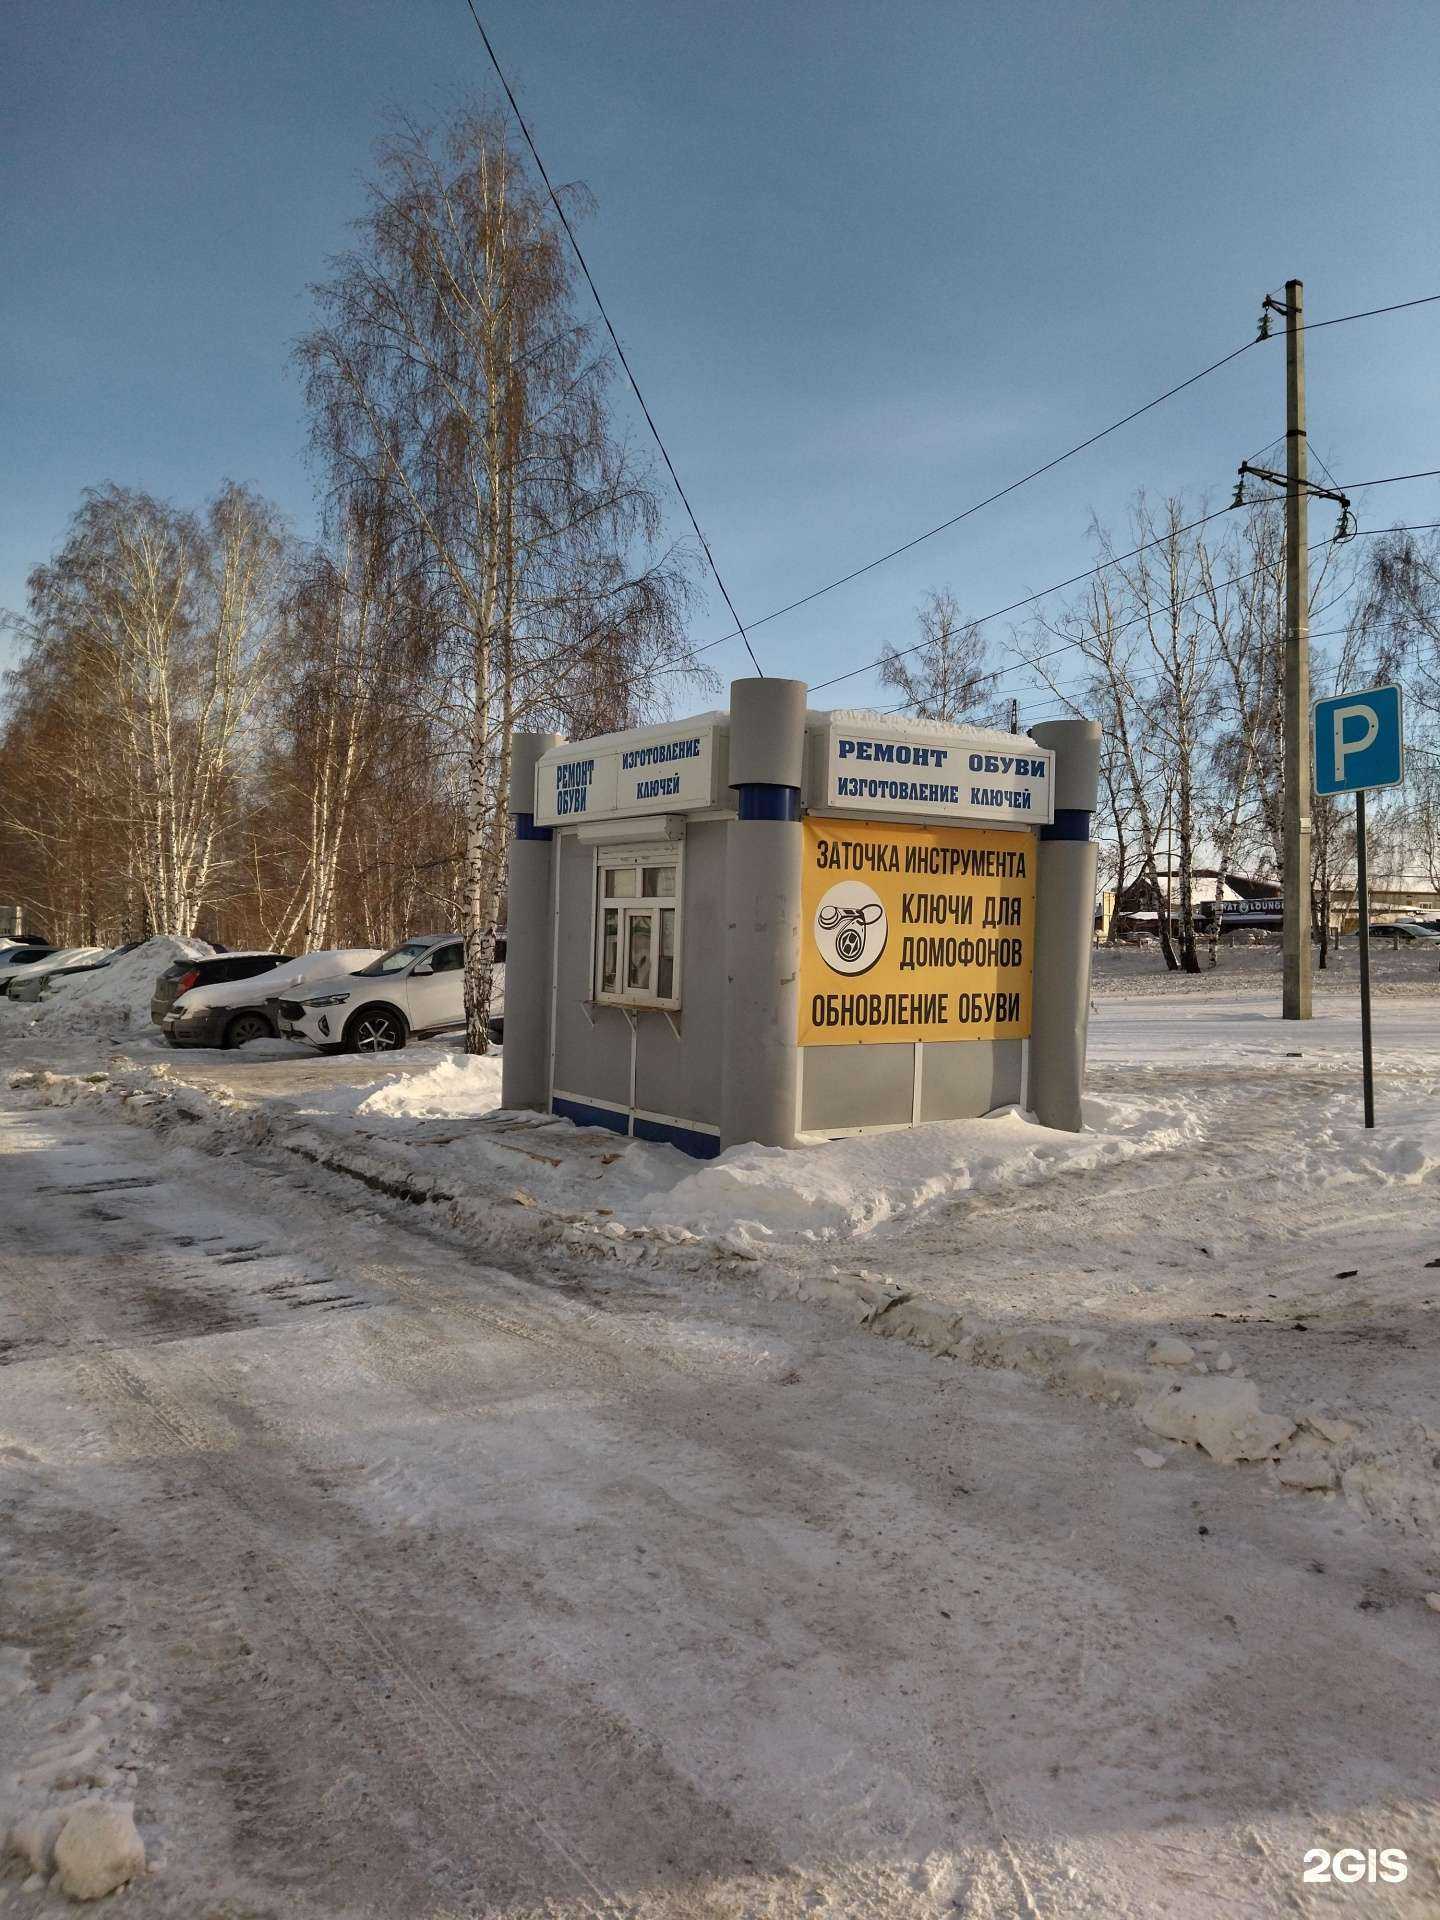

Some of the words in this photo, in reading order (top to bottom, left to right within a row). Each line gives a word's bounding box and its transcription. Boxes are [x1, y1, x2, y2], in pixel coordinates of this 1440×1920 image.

[622, 738, 701, 770] ИЗГОТОВЛЕНИЕ
[838, 739, 948, 768] РЕМОНТ
[968, 753, 1046, 778] ОБУВИ
[1333, 704, 1379, 782] P
[556, 760, 594, 790] РЕМОНТ
[636, 772, 681, 800] КЛЮЧЕЙ
[557, 786, 587, 816] ОБУВИ
[837, 776, 959, 804] ИЗГОТОВЛЕНИЕ
[970, 788, 1032, 810] КЛЮЧЕЙ
[816, 839, 900, 873] ЗАТОЧКА
[904, 846, 1026, 879] ИНСТРУМЕНТА
[901, 893, 973, 925] КЛЮЧИ
[982, 896, 1022, 929] ДЛЯ
[899, 936, 1023, 971] ДОМОФОНОВ
[811, 993, 949, 1027] ОБНОВЛЕНИЕ
[958, 992, 1020, 1024] ОБУВИ
